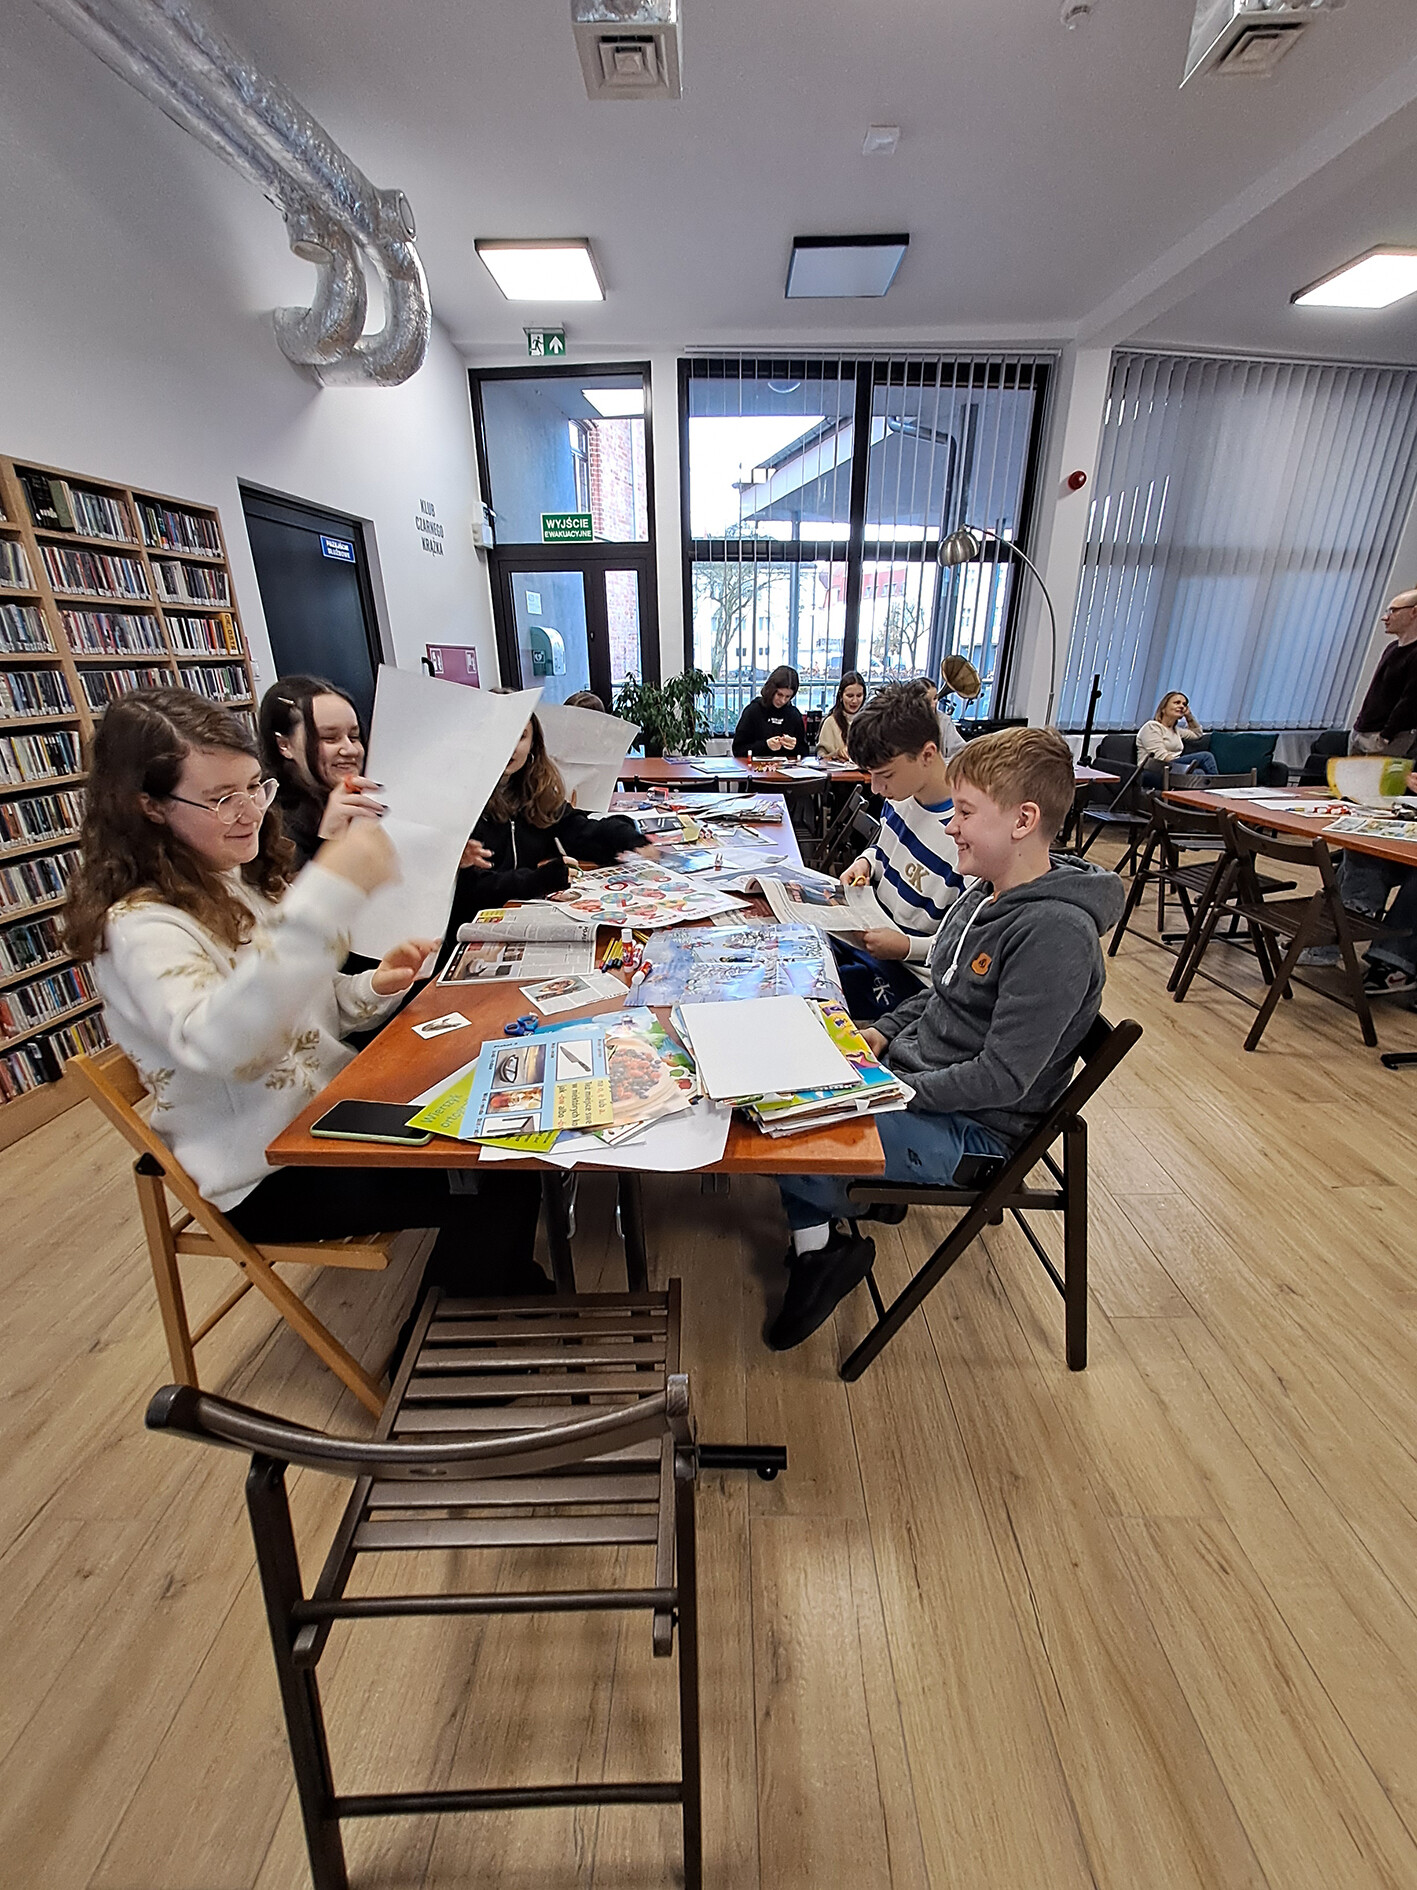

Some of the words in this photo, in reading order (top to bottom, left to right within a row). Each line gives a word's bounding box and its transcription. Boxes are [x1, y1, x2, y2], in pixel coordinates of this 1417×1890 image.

[420, 498, 436, 517] KLUB
[415, 515, 444, 539] CZARNEGO
[546, 516, 589, 529] WYJŚCIE
[544, 530, 592, 538] EWAKUACYJNE
[421, 536, 444, 557] KRĄŻKA
[904, 862, 930, 893] CK
[570, 1089, 581, 1118] niektórych
[583, 1091, 593, 1111] miejsce
[558, 1105, 567, 1118] albo
